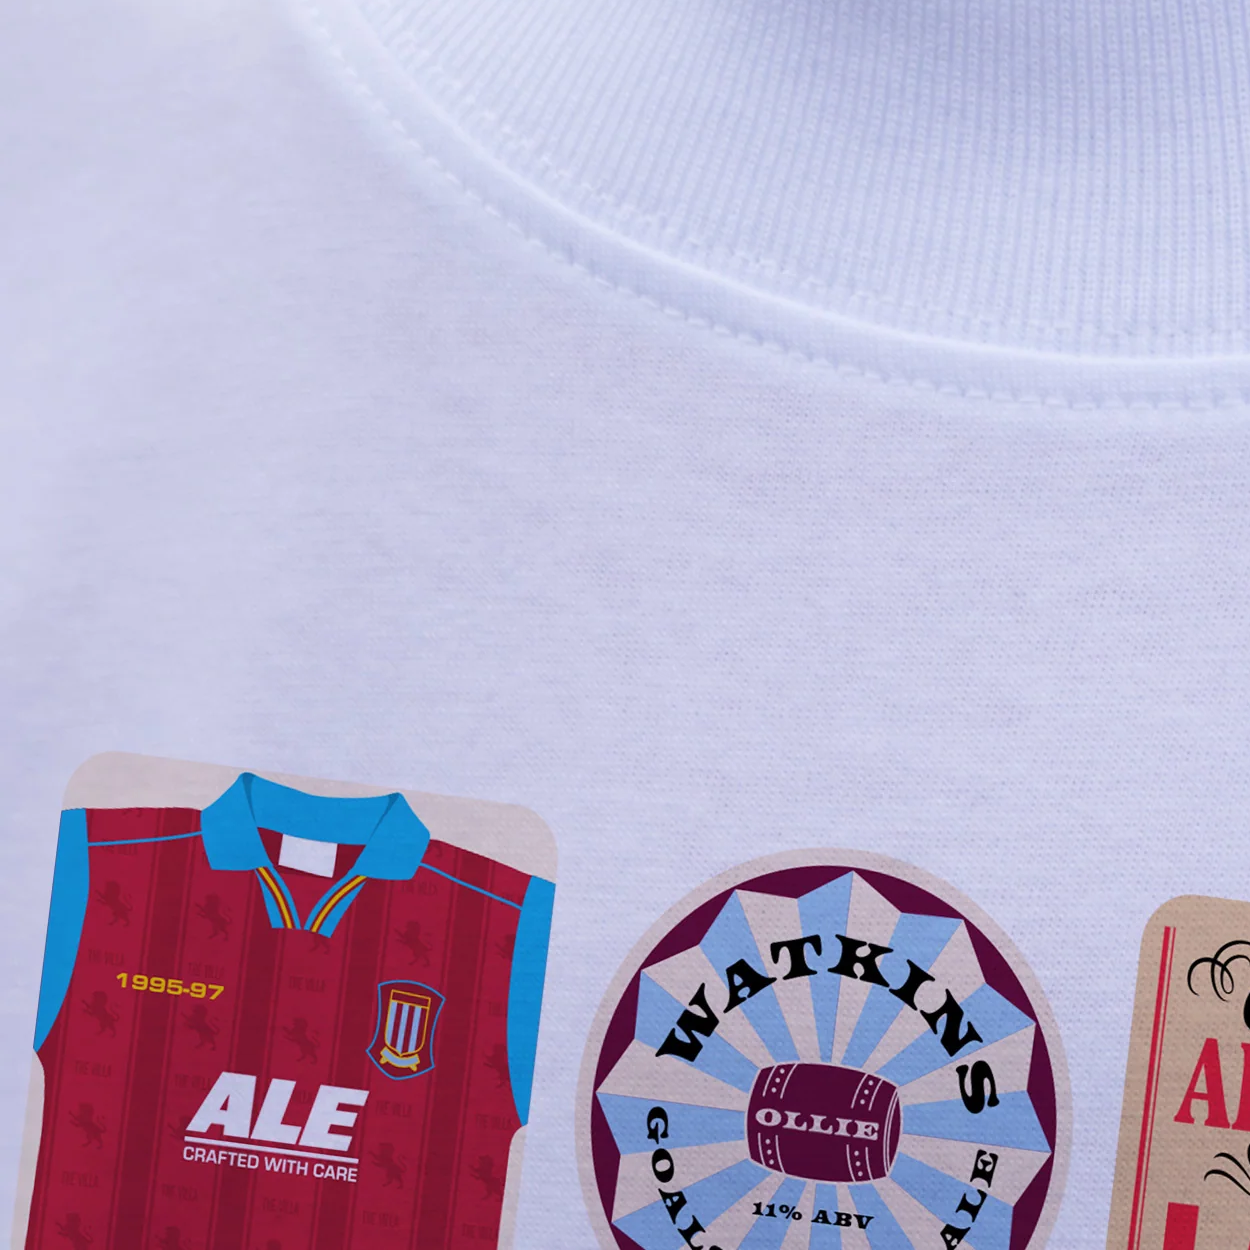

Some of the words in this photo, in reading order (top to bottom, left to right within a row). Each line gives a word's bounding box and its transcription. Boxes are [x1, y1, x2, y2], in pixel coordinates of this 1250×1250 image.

[116, 972, 225, 1001] 1995-97
[656, 934, 1000, 1114] WATKINS
[185, 1071, 370, 1152] ALE
[755, 1108, 879, 1141] OLLIE
[183, 1146, 260, 1170] CRAFTED
[264, 1156, 309, 1176] WITH
[313, 1163, 358, 1183] CARE
[646, 1106, 723, 1250] GOAL
[752, 1201, 803, 1222] 11%
[811, 1209, 875, 1231] ABV
